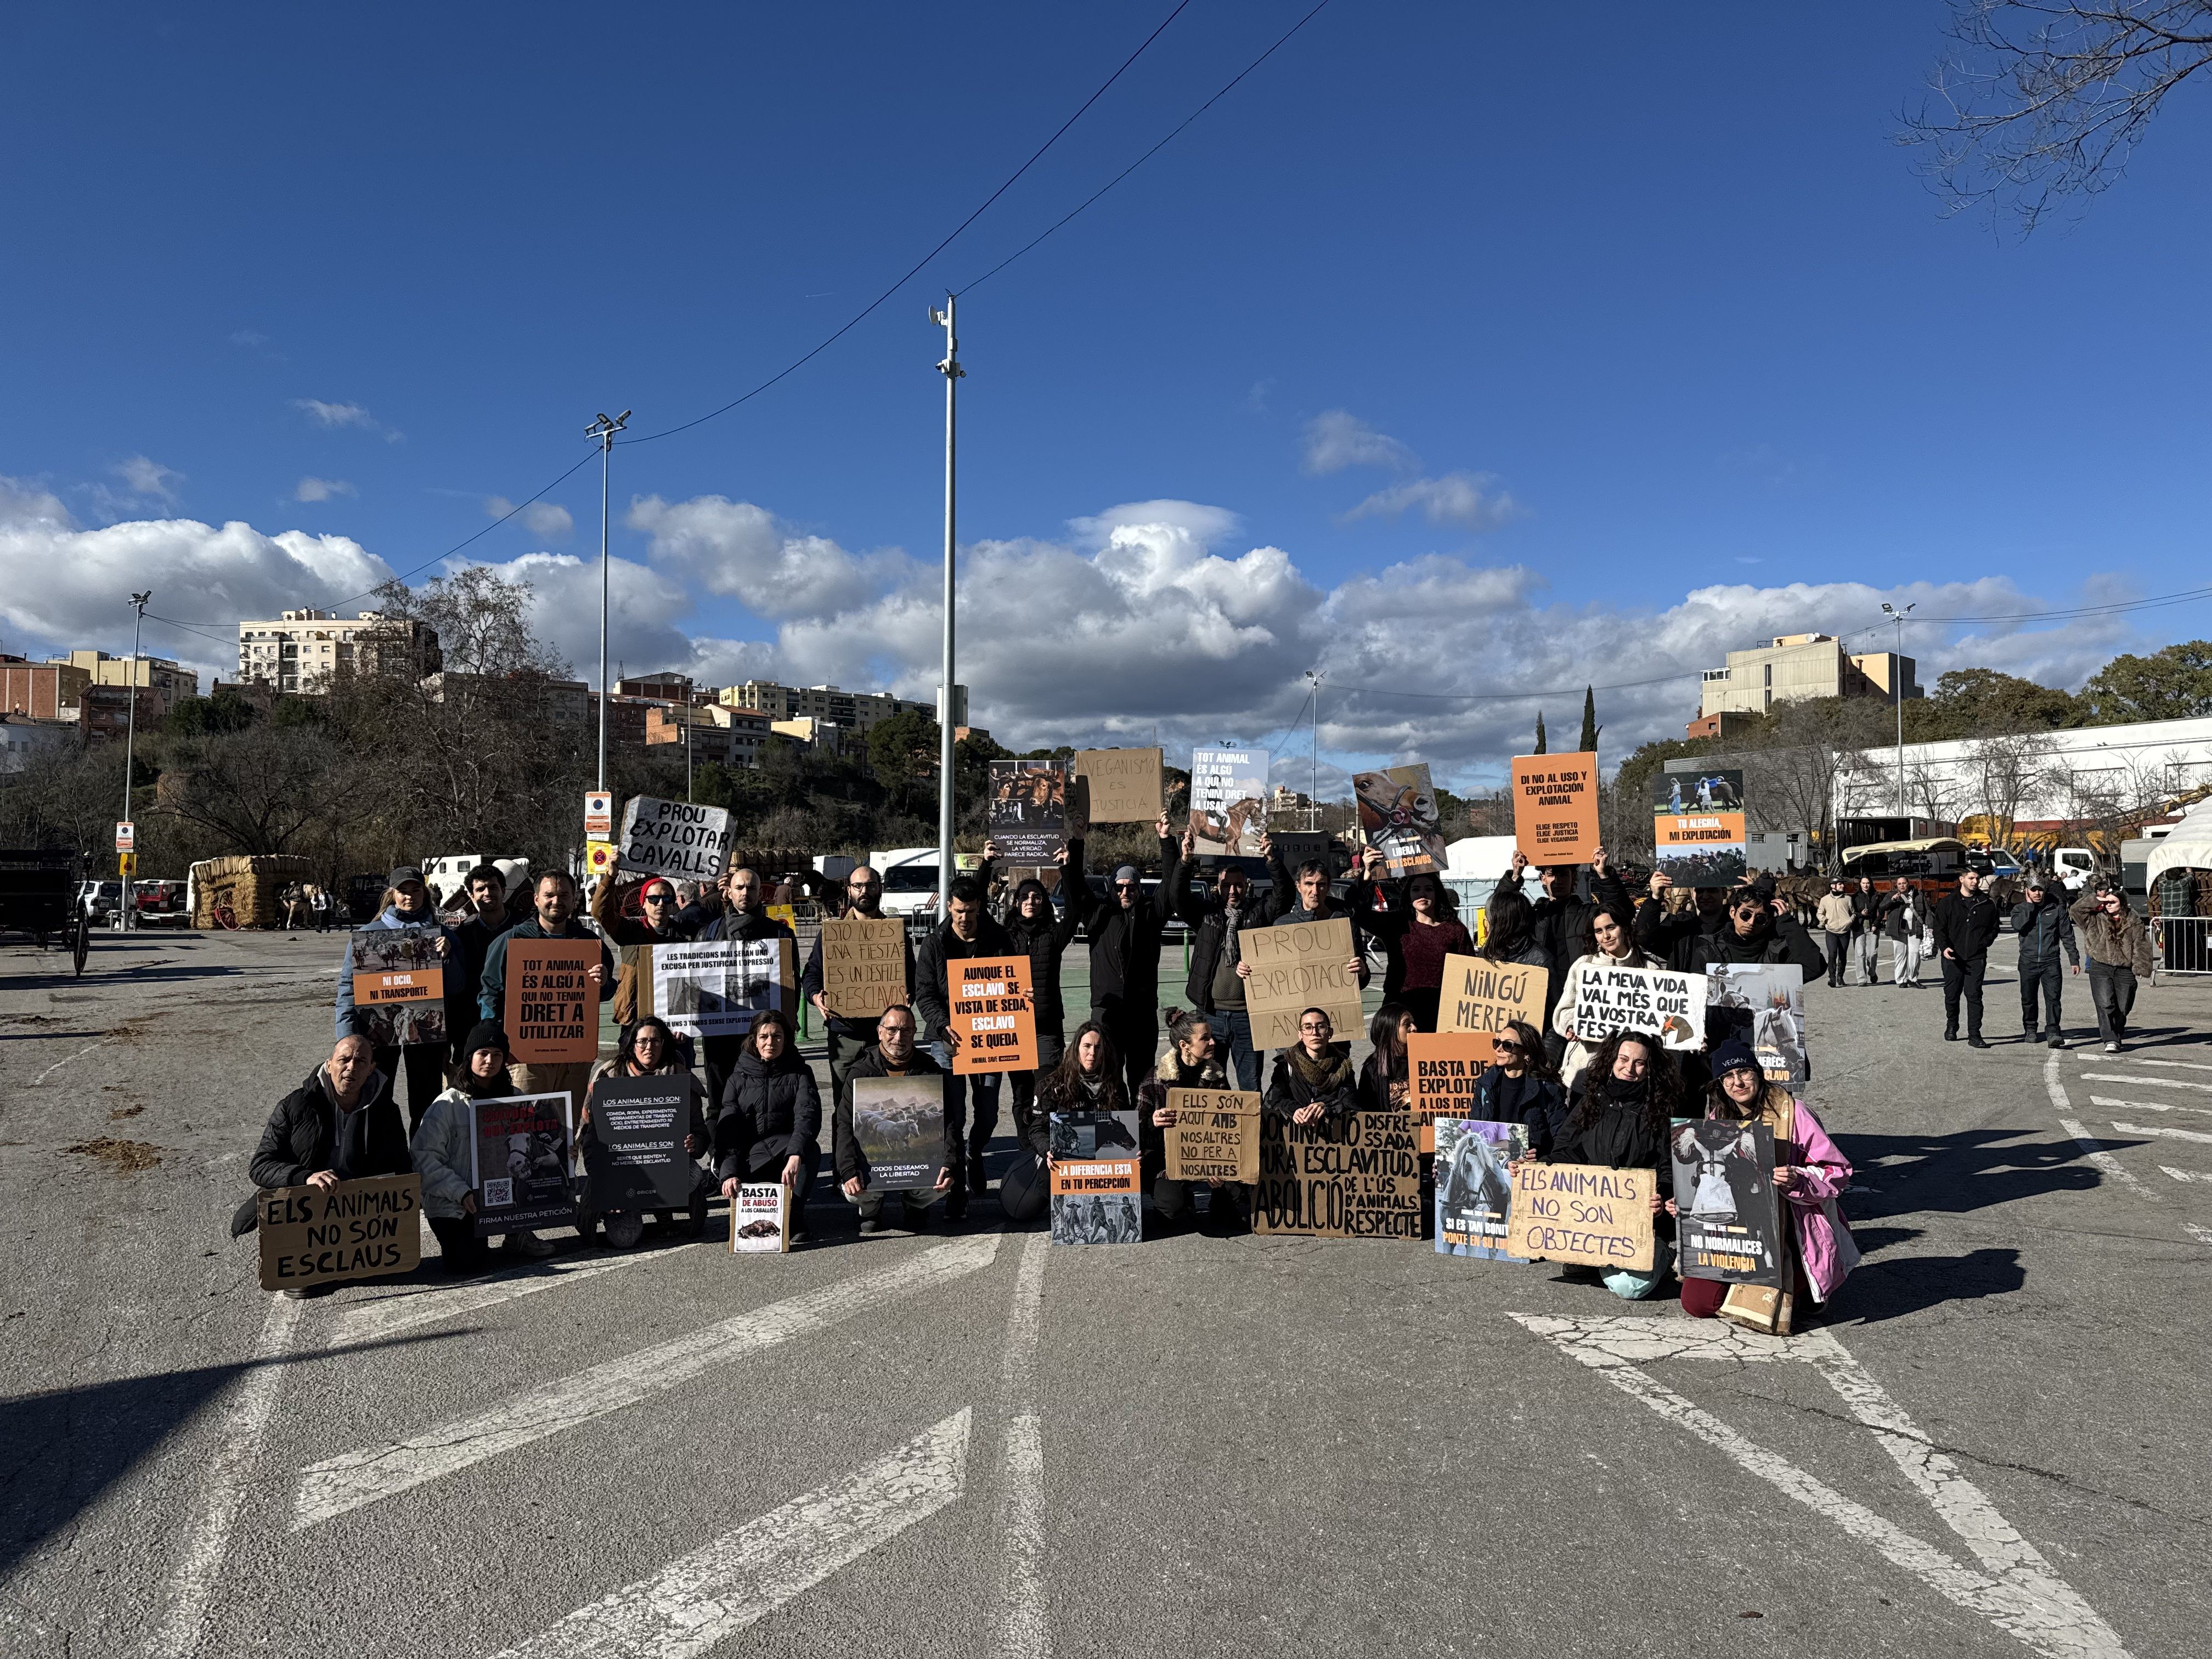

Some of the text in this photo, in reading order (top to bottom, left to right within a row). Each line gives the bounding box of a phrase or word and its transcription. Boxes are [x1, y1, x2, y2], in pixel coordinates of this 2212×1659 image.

[1198, 753, 1250, 764] TOT ANIMAL
[1086, 758, 1155, 776] VEGANISMO
[1521, 771, 1587, 784] DI NO AL USO Y
[1196, 788, 1247, 799] TENIM DRET
[1526, 781, 1583, 795] EXPLOTACIÓN
[1539, 795, 1572, 805] ANIMAL
[659, 803, 706, 823] PROU
[630, 819, 730, 850] EXPLOTAR
[1669, 828, 1731, 840] MI EXPLOTACIÓN
[628, 843, 721, 877] CAVALLS
[1253, 927, 1331, 957] PROU
[523, 960, 586, 970] TOT ANIMAL
[701, 960, 737, 968] JUSTIFICAR
[739, 957, 774, 966] L'OPRESSIÓ
[522, 972, 585, 988] ÉS ALGÚ A
[828, 963, 902, 984] ES UN DESFILE
[964, 966, 1015, 980] AUNQUE EL
[962, 982, 1019, 997] ESCLAVO SE
[1583, 970, 1688, 994] LA MEVA VIDA
[370, 986, 428, 1000] NI TRANSPORTE
[522, 992, 584, 1002] QUI NO TENIM
[1583, 988, 1688, 1014] VAL MÉS QUE
[521, 1003, 584, 1022] DRET A
[955, 998, 1029, 1014] VISTA DE SEDA,
[972, 1015, 1014, 1031] ESCLAVO
[1578, 1004, 1659, 1027] LA VOSTRA
[520, 1025, 584, 1039] UTILITZAR
[971, 1033, 1018, 1049] SE QUEDA
[1183, 1094, 1243, 1109] ELLS SÓN
[1420, 1098, 1450, 1109] A LOS
[1178, 1110, 1237, 1128] AQUÍ AMB
[1181, 1131, 1240, 1145] NOSALTRES
[1182, 1146, 1237, 1159] NO PER A
[1059, 1161, 1132, 1176] LA DIFERENCIA ESTÁ
[1181, 1164, 1237, 1176] NOSALTRES
[1305, 1147, 1418, 1179] ESCLAVITUD.
[1062, 1175, 1130, 1190] EN TU PERCEPCIÓN
[742, 1188, 778, 1197] BASTA
[268, 1189, 414, 1224] ELS ANIMALS
[1254, 1175, 1343, 1229] ABOLICIÓ
[504, 1212, 537, 1221] NUESTRA
[539, 1207, 572, 1217] PETICIÓN
[1532, 1197, 1613, 1224] NO SON
[307, 1215, 398, 1248] NO SÓN
[1345, 1210, 1421, 1237] RESPECTE
[1446, 1218, 1483, 1233] SI ES TAN
[1527, 1226, 1635, 1257] OBJECTES
[1691, 1235, 1762, 1255] NO NORMALICES
[278, 1244, 400, 1277] ESCLAUS
[1698, 1252, 1756, 1271] LA VIOLENCIA
